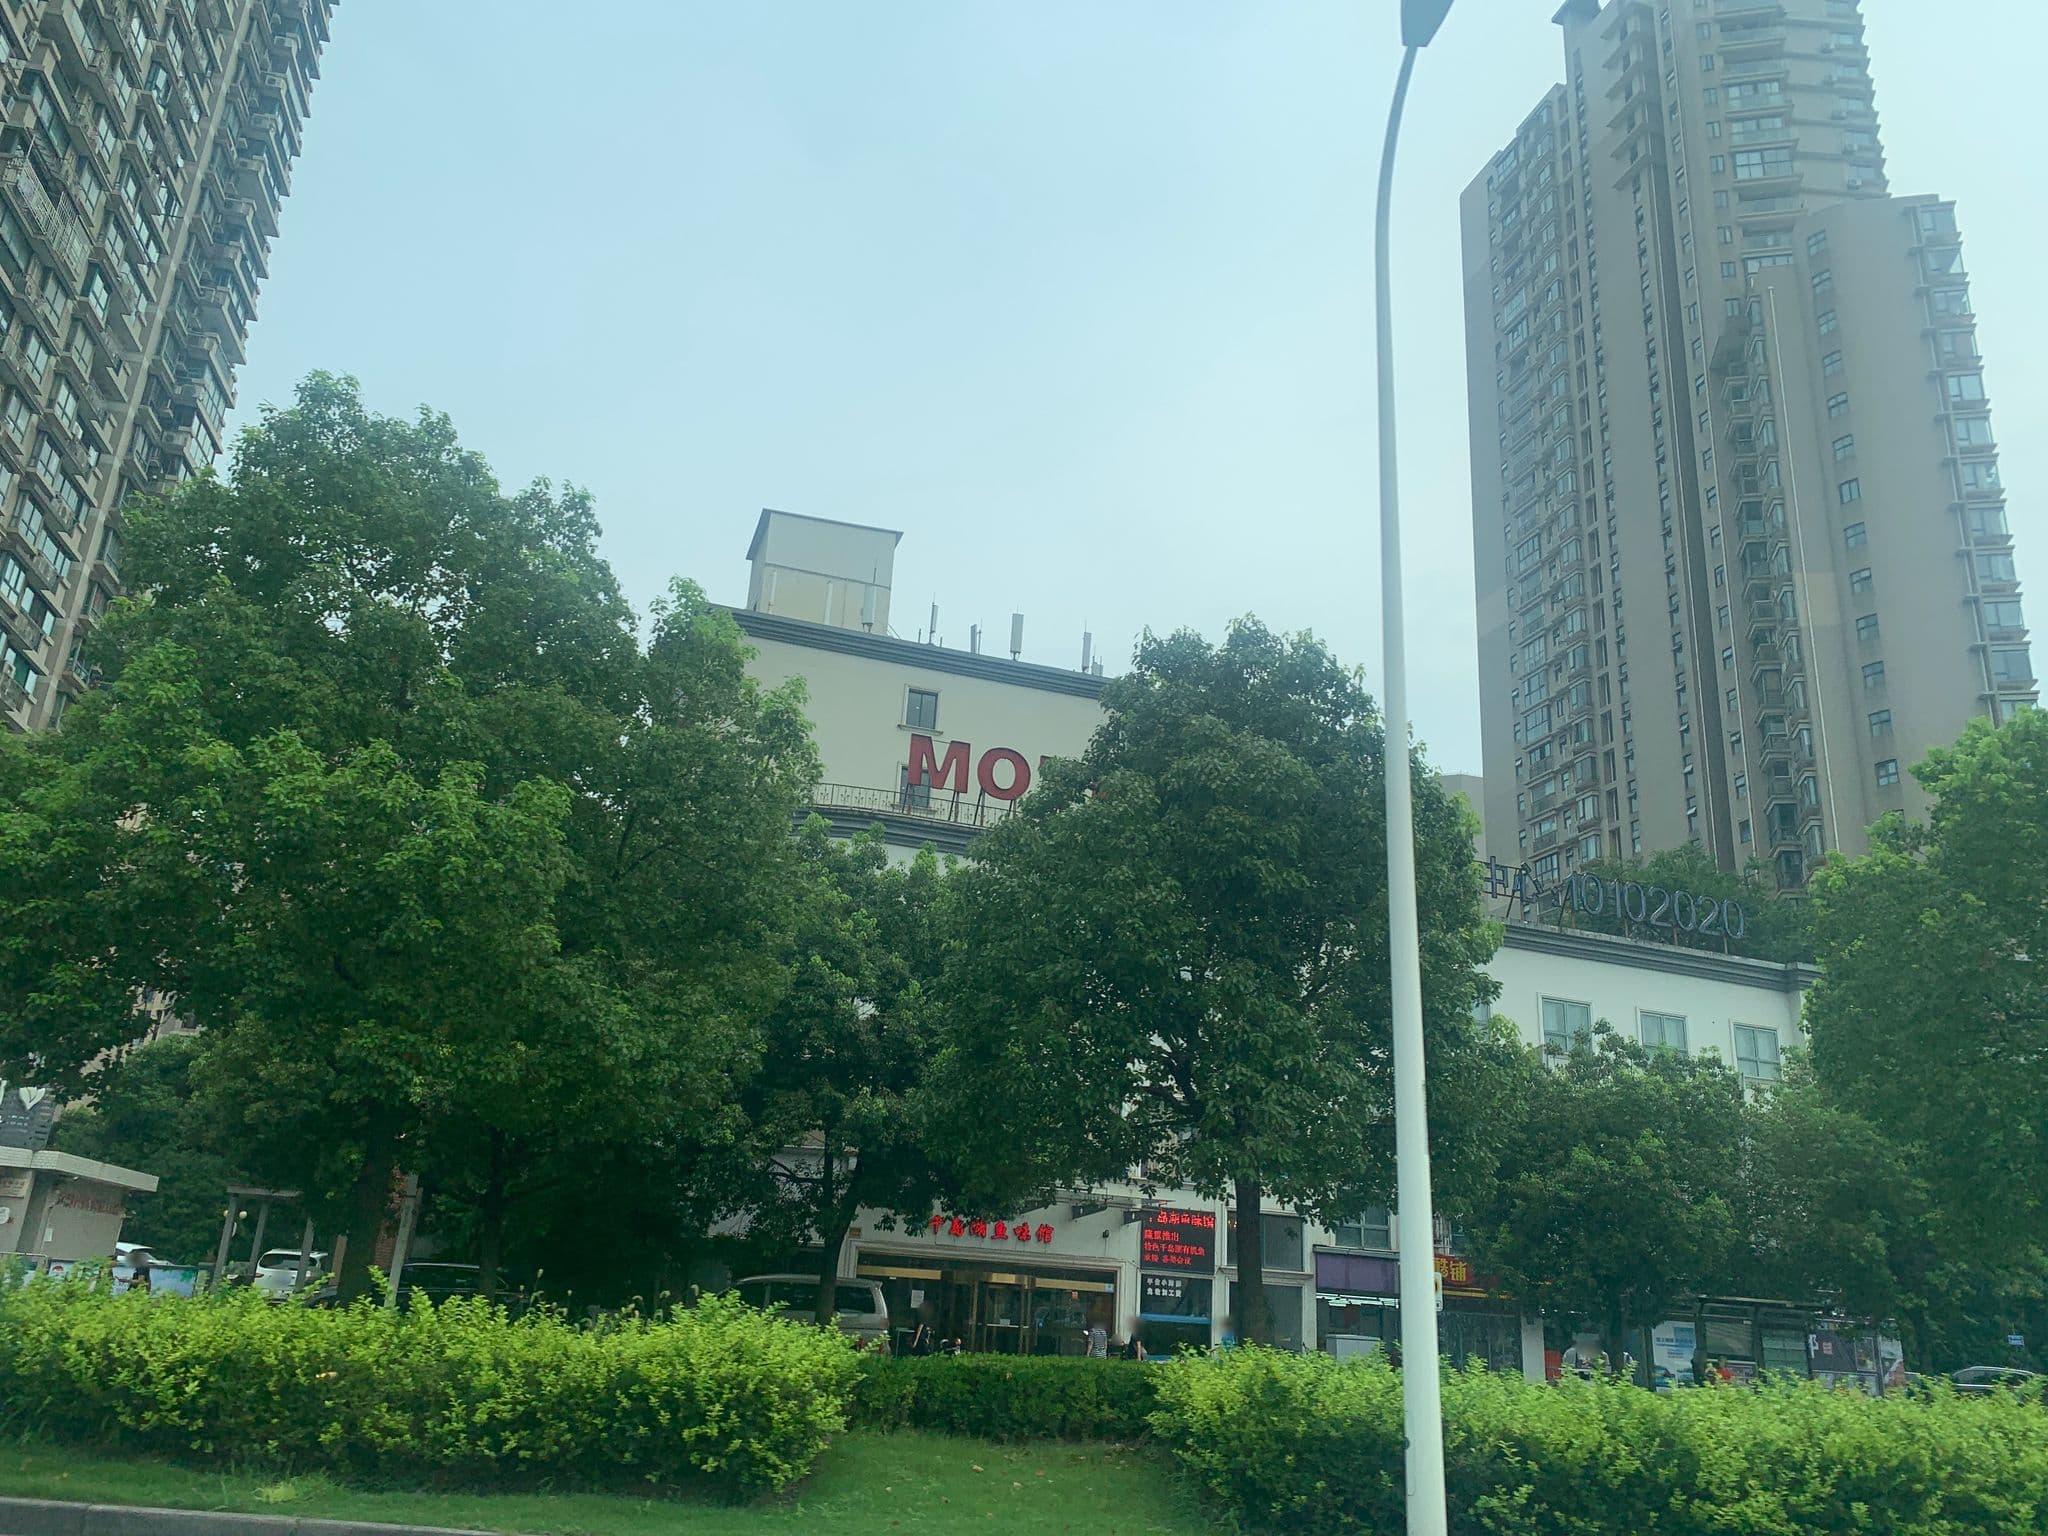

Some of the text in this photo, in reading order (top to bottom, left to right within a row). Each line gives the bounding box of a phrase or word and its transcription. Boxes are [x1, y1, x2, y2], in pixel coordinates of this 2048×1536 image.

[928, 1215, 1054, 1243] 千岛湖鱼味馆
